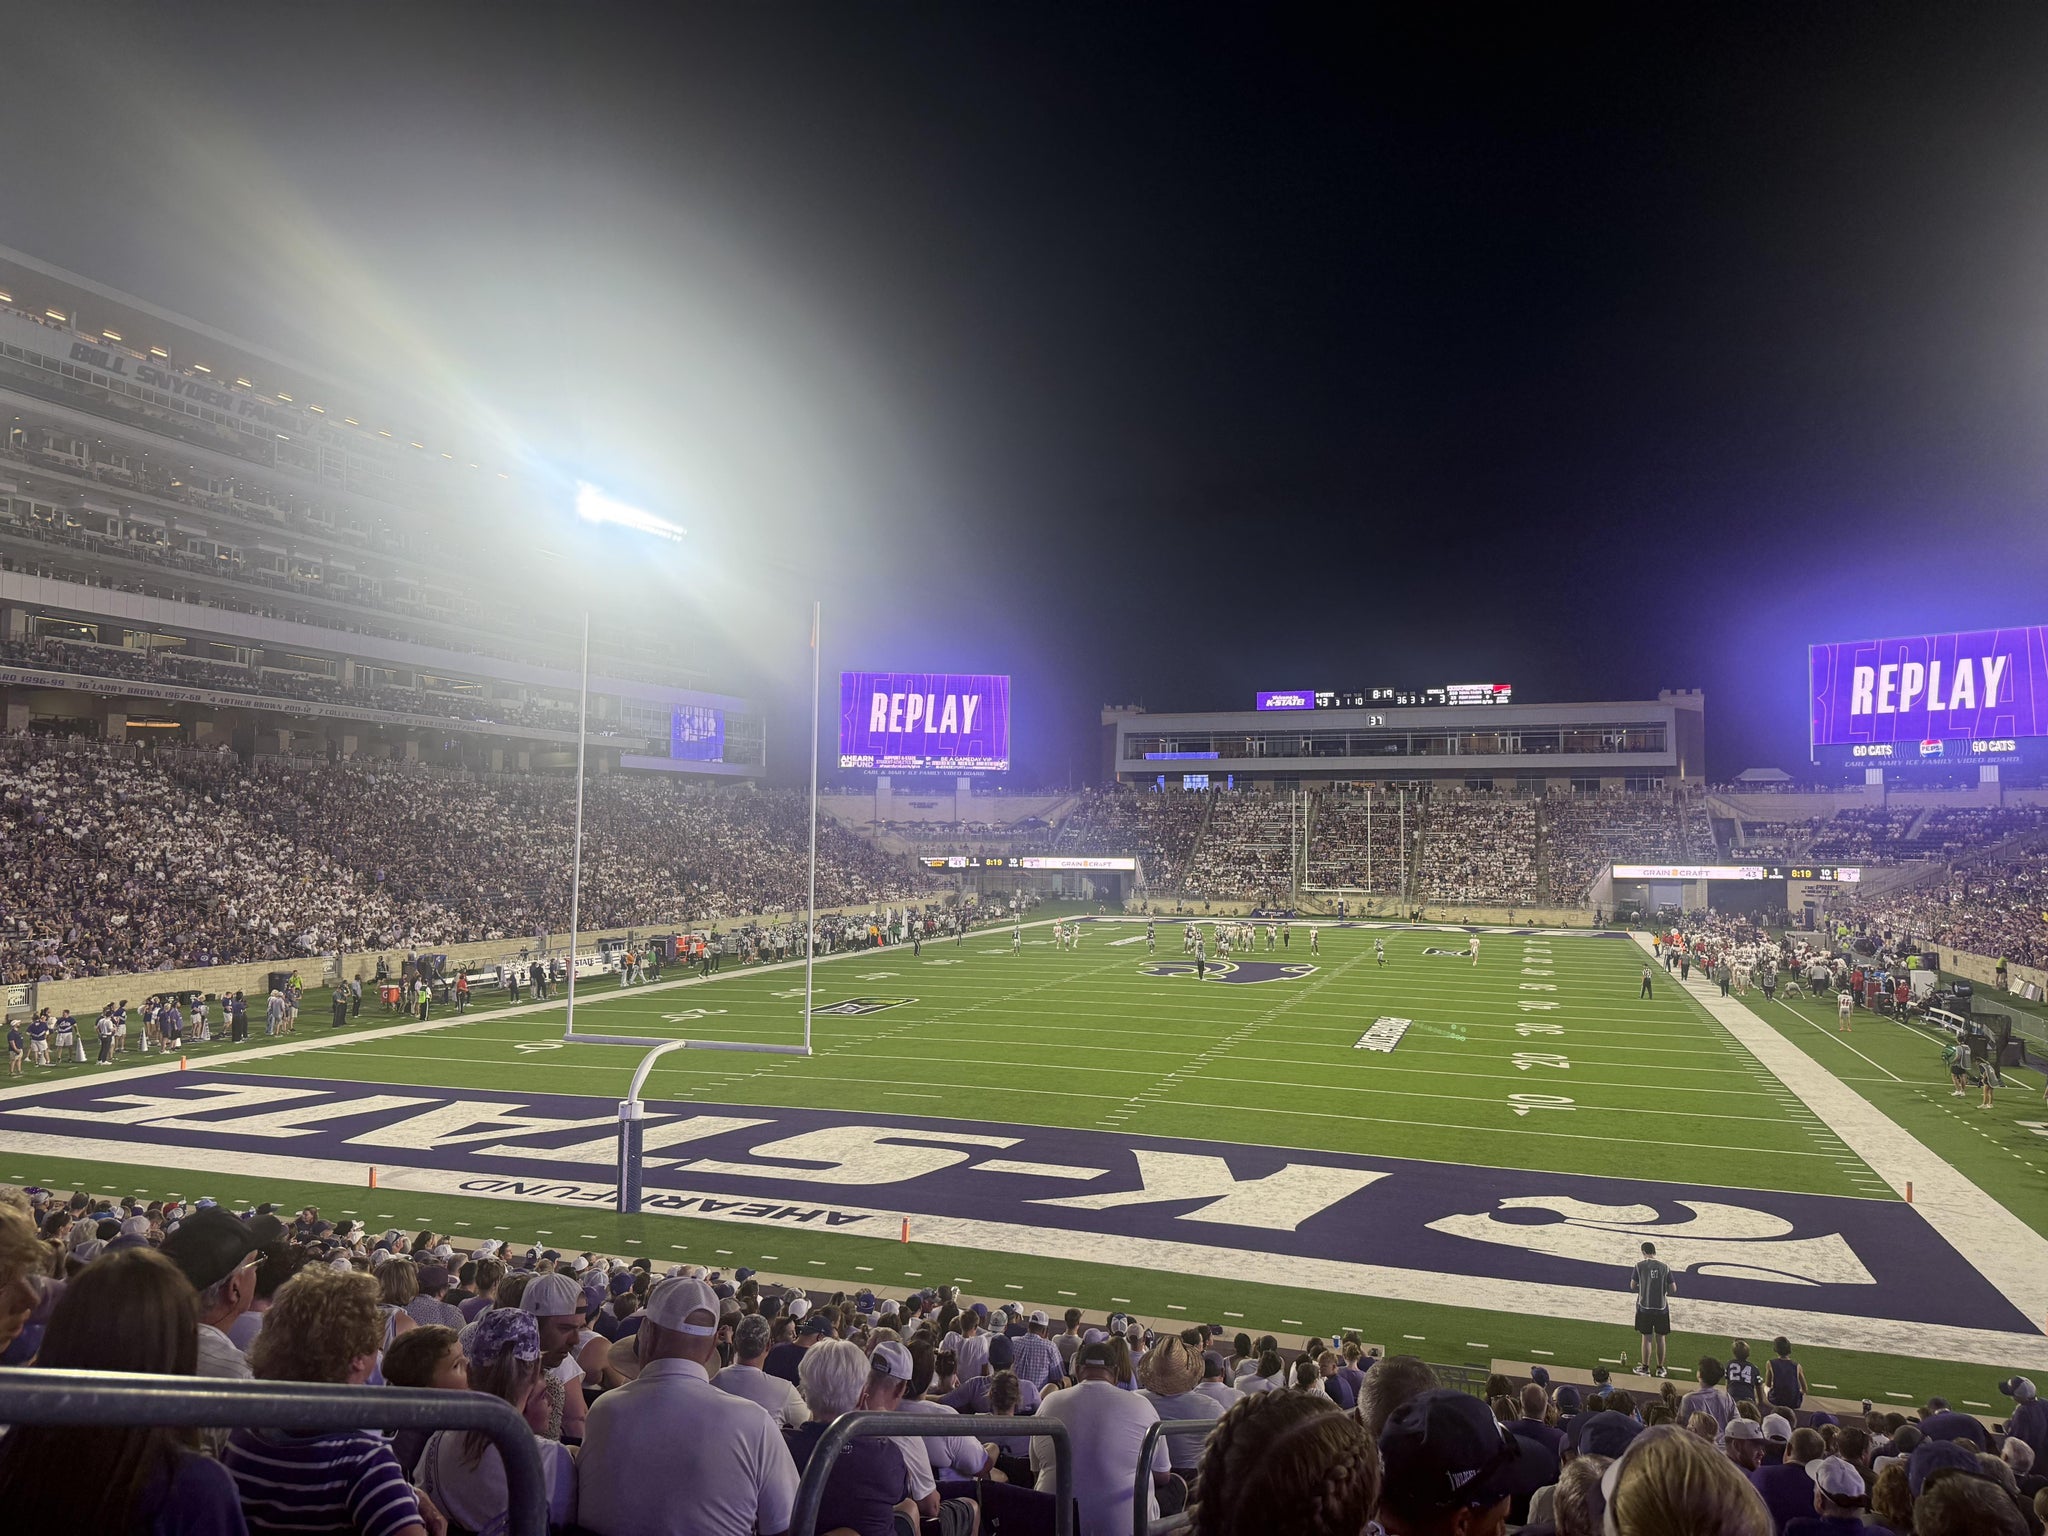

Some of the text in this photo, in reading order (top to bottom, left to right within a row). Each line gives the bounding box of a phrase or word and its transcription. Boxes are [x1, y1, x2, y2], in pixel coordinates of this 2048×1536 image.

[69, 342, 128, 376] BILL
[135, 365, 233, 411] SNYDER
[92, 683, 123, 694] LARRY
[127, 687, 161, 697] BROWN
[1851, 655, 2006, 715] REPLAY
[1372, 689, 1393, 699] 8:19
[1316, 698, 1328, 707] 43
[1355, 697, 1363, 705] 10
[1397, 696, 1407, 704] 36
[1410, 696, 1416, 704] 3
[1440, 695, 1446, 704] 3
[253, 701, 282, 711] BROWN
[869, 692, 978, 734] REPLAY
[1370, 716, 1383, 726] 37
[1853, 745, 1892, 756] GO CATS
[1972, 740, 2015, 752] GO CATS
[1921, 758, 1953, 766] FAMILY
[1791, 870, 1812, 878] 8:19
[1511, 1053, 1570, 1069] 20
[1507, 1094, 1576, 1110] 10
[459, 1179, 617, 1201] FUND
[1729, 1363, 1751, 1382] 24
